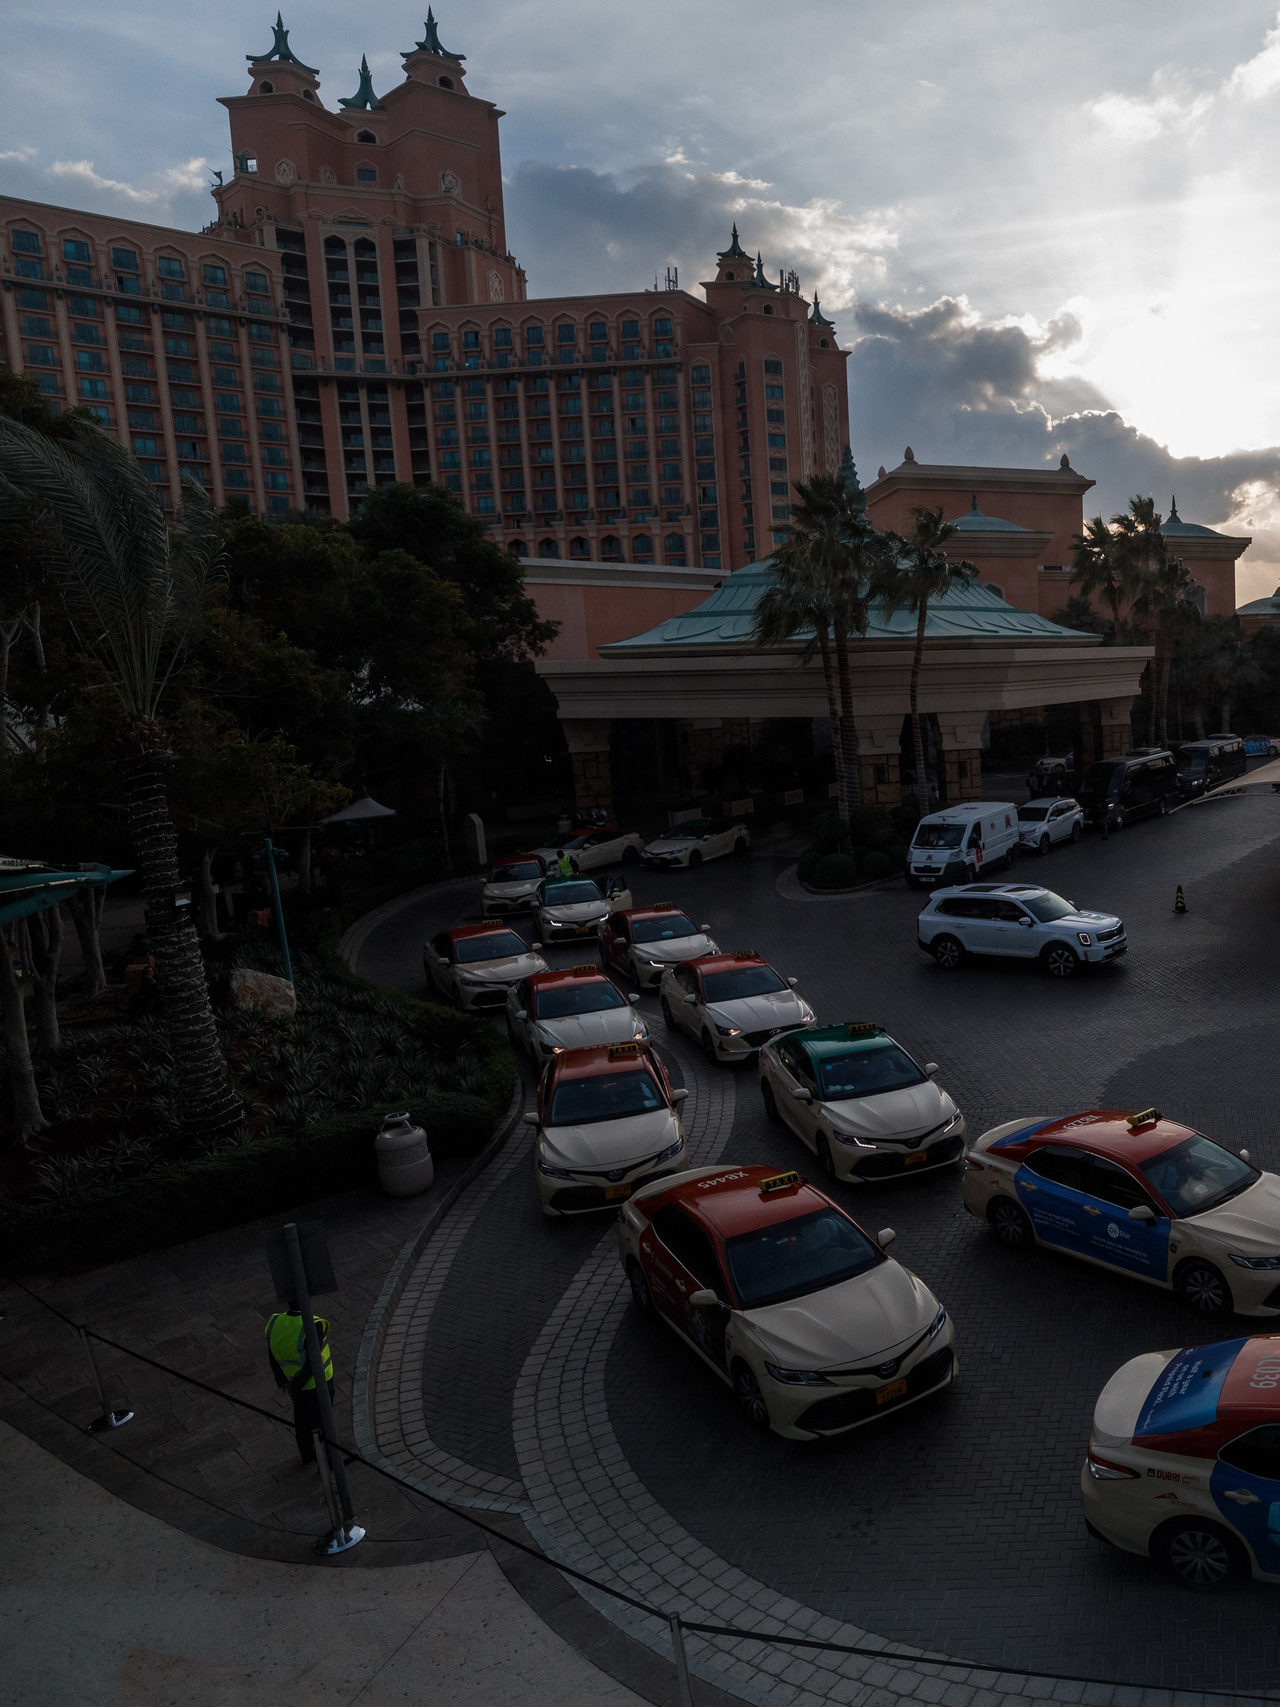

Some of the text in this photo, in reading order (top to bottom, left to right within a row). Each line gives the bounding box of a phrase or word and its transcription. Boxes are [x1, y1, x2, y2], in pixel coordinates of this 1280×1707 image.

[698, 1171, 750, 1189] XB445
[769, 1174, 794, 1188] TAXI
[1156, 1470, 1180, 1482] DUBAI
